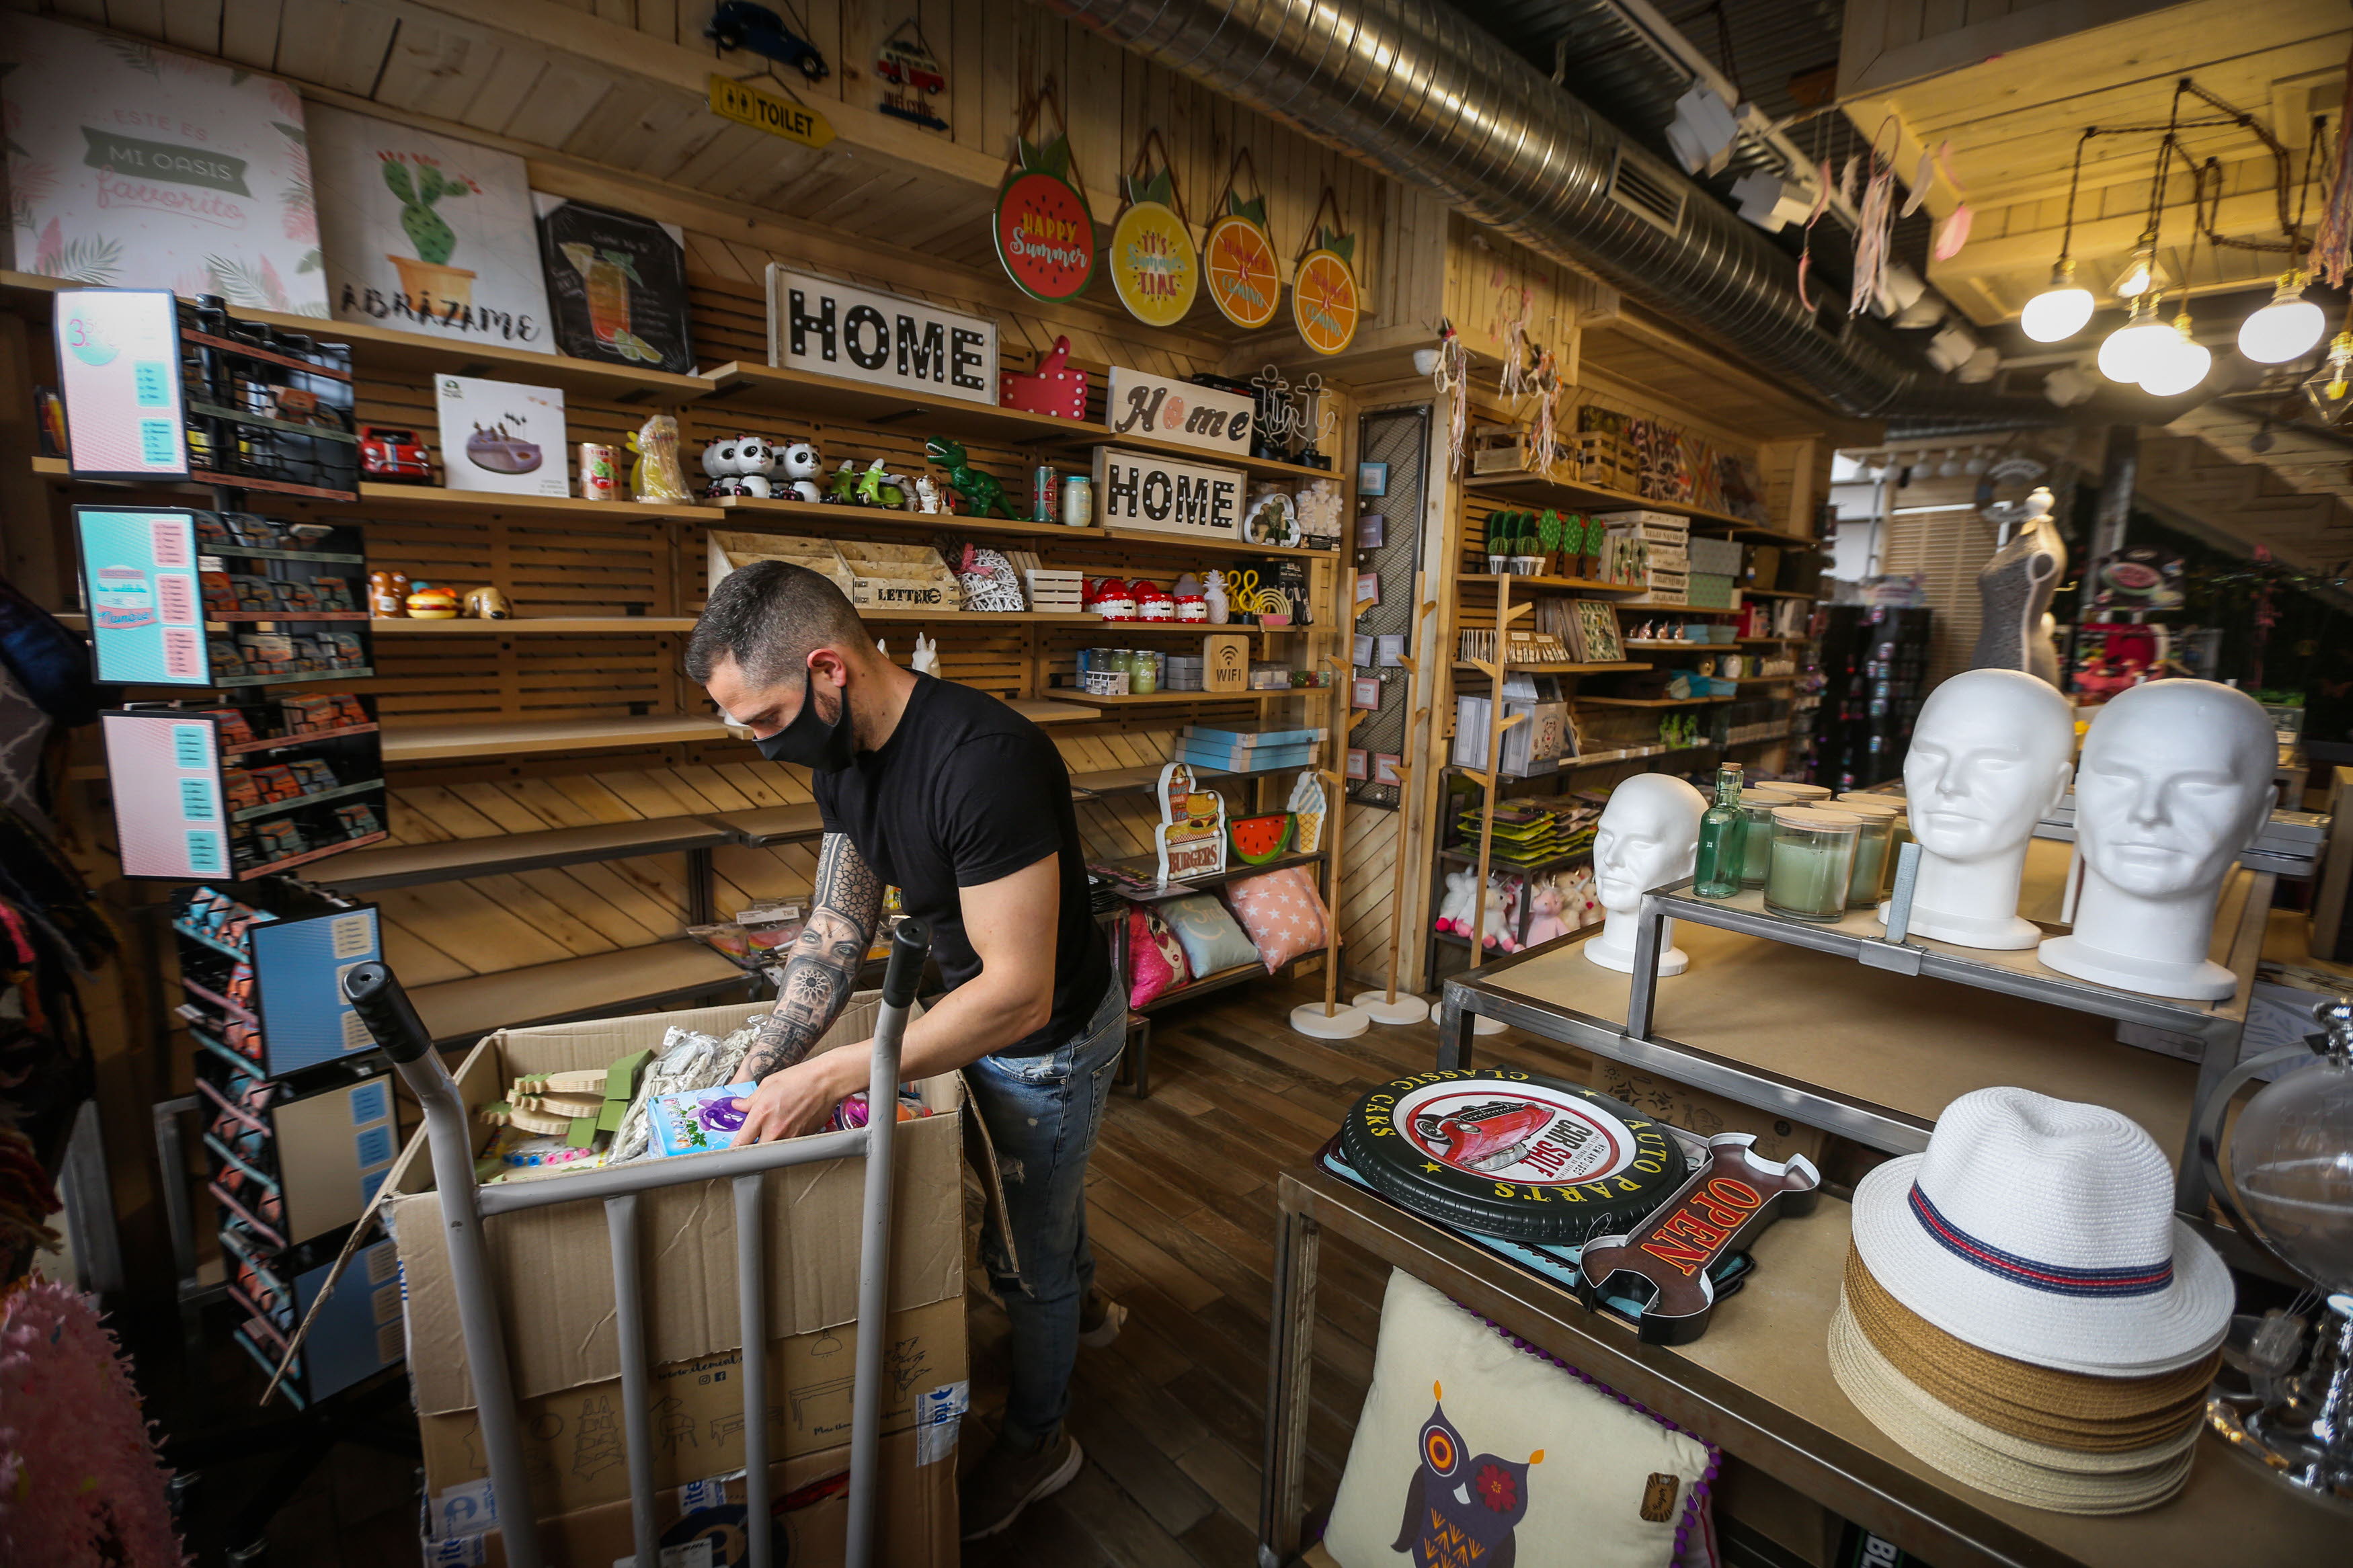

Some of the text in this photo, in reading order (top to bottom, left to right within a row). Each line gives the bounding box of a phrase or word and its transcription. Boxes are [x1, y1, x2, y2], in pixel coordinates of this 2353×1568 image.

[114, 109, 208, 142] ESTE ES
[757, 98, 814, 138] TOILET
[108, 145, 234, 181] MI OASIS
[95, 164, 247, 222] favorito
[1023, 212, 1078, 243] HAPPY
[1142, 234, 1168, 255] IT'S
[1010, 226, 1088, 268] Summer
[1138, 271, 1176, 296] TIME
[1222, 275, 1265, 308] COMING
[1305, 304, 1341, 337] COMING
[789, 288, 984, 390] HOME
[1115, 386, 1250, 441] Home
[1107, 464, 1234, 528] HOME
[1216, 668, 1242, 682] WIFI
[1168, 844, 1218, 874] BURGERS
[1390, 1069, 1529, 1091] CLASSIC
[1365, 1094, 1396, 1137] CARS
[1517, 1119, 1594, 1179] CAR SALE
[1572, 1144, 1607, 1176] NEW AND USED
[1624, 1118, 1667, 1173] AUTO
[1640, 1178, 1762, 1276] OPEN
